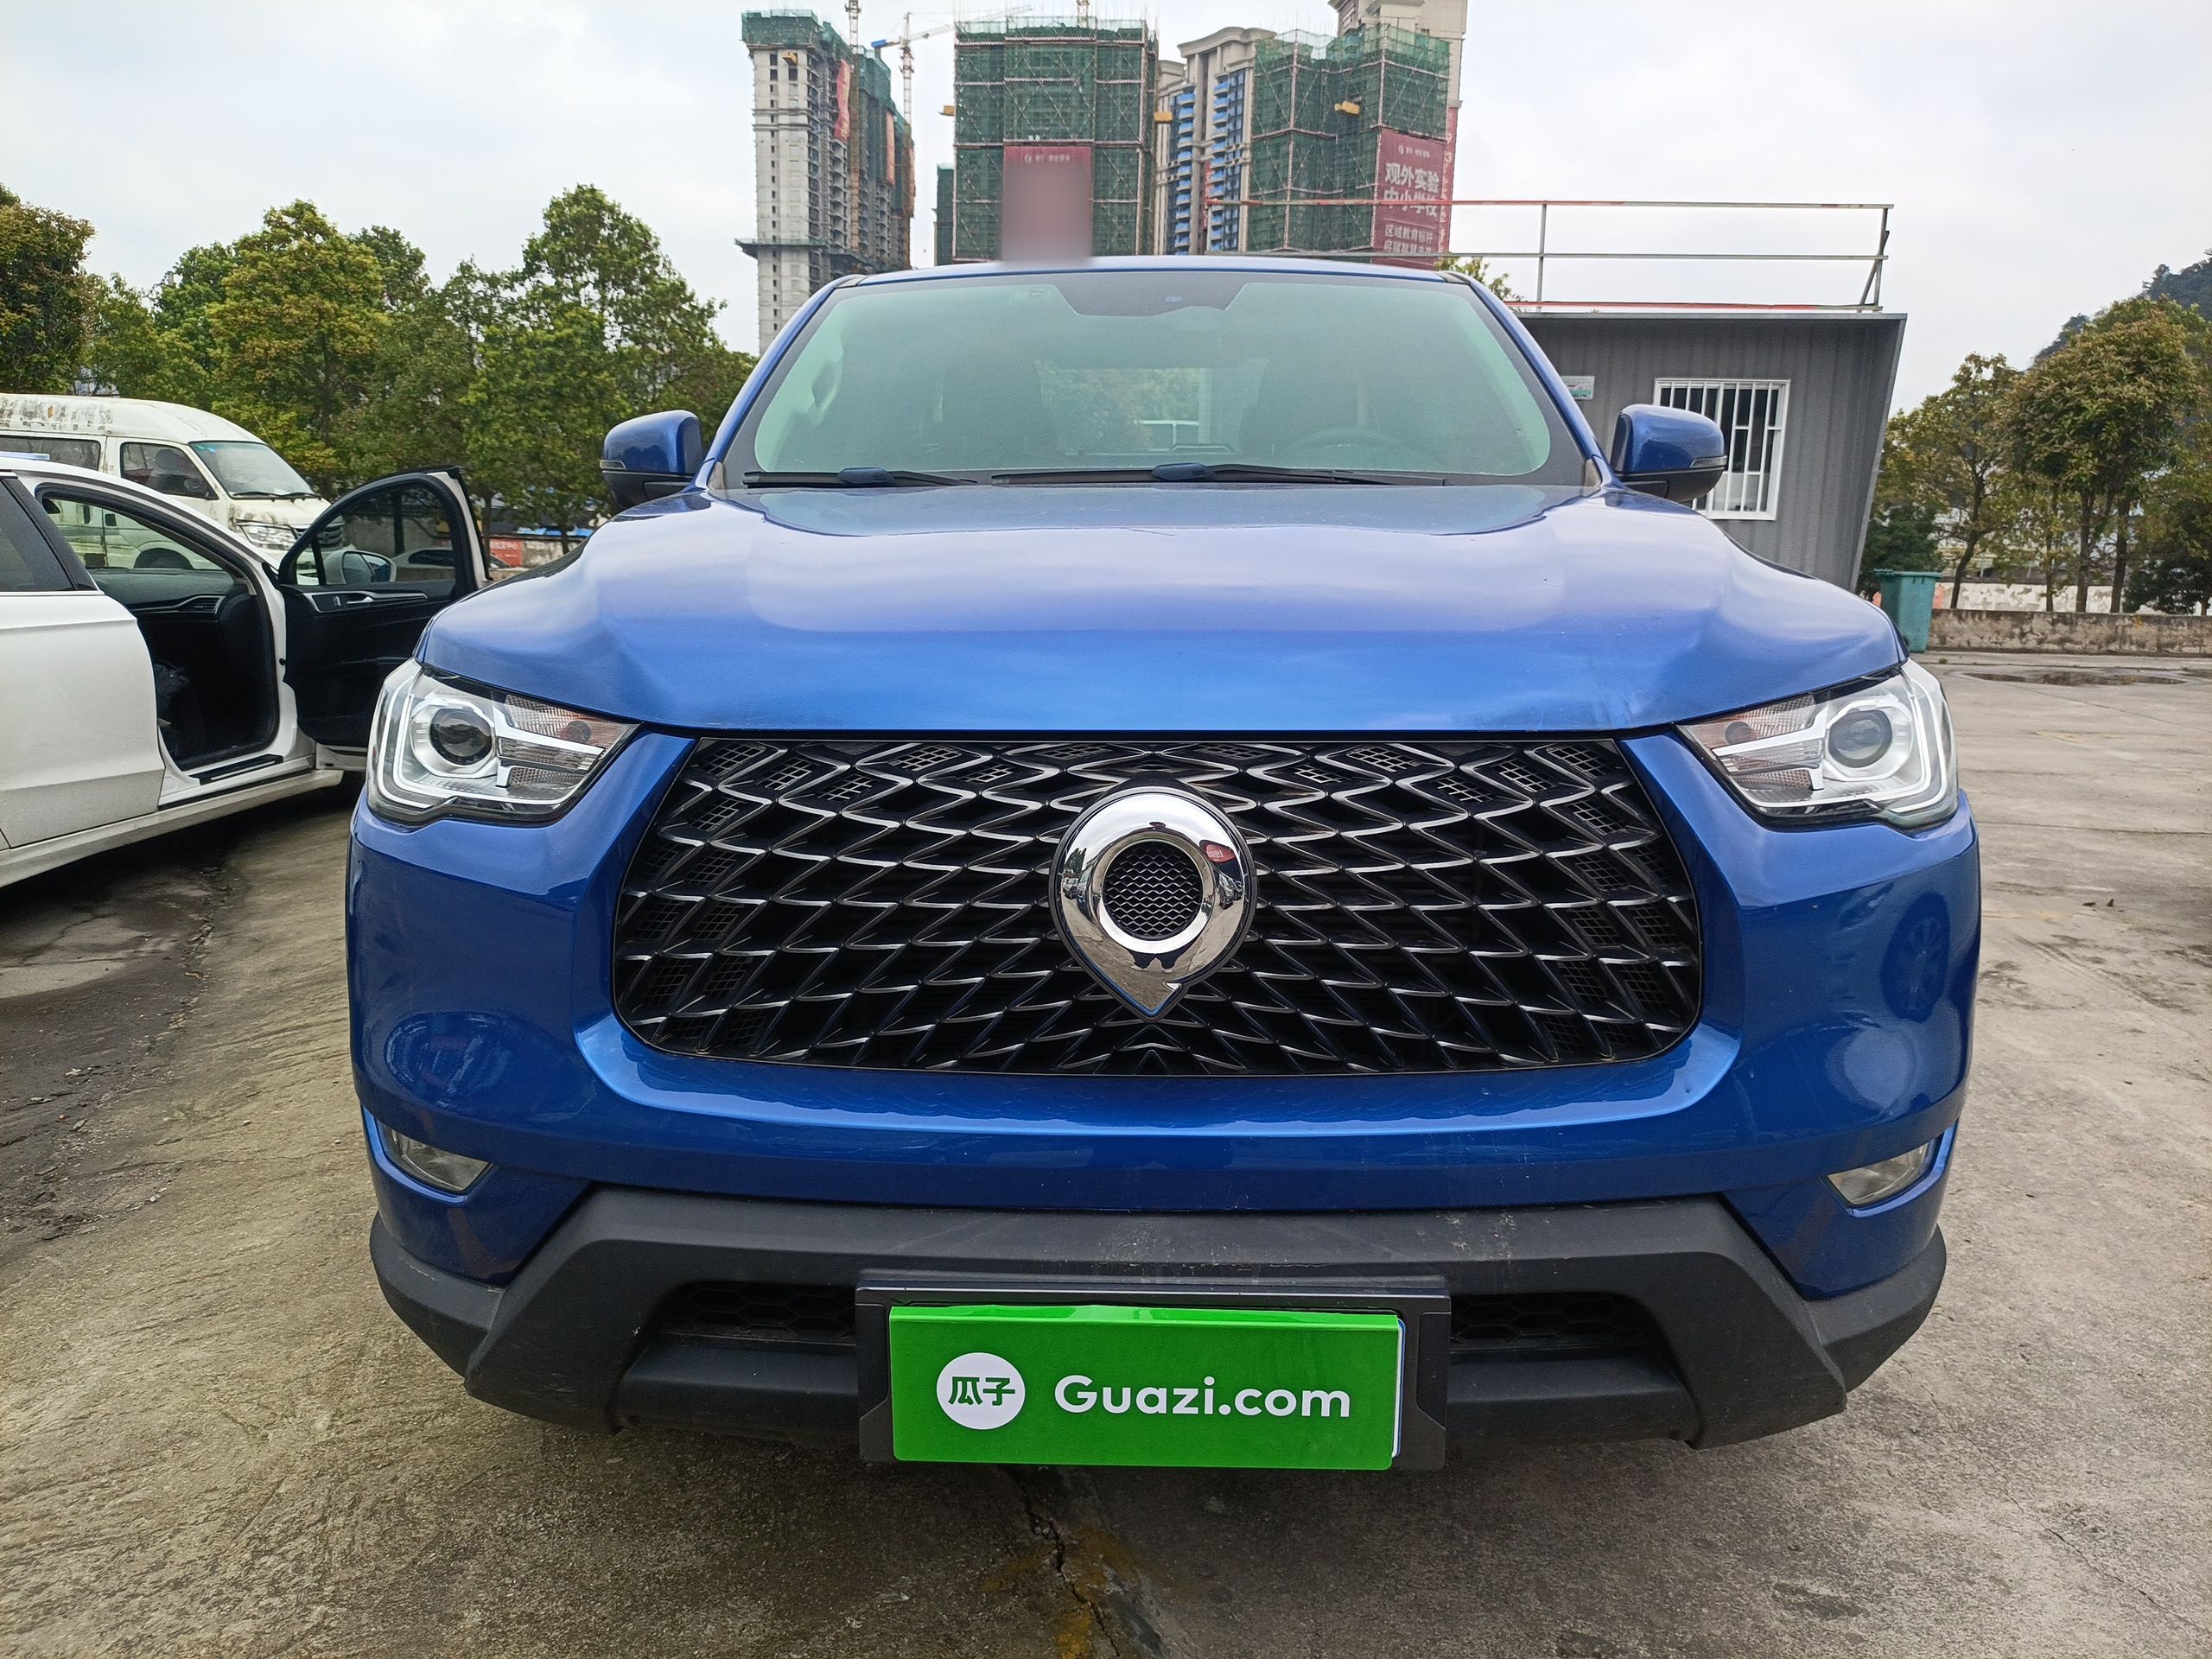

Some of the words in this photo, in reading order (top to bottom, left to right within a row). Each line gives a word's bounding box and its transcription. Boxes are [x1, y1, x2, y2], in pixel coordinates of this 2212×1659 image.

[1385, 162, 1440, 194] 观外实验
[948, 1376, 1016, 1407] 瓜子
[1054, 1375, 1351, 1417] Guazi.com
